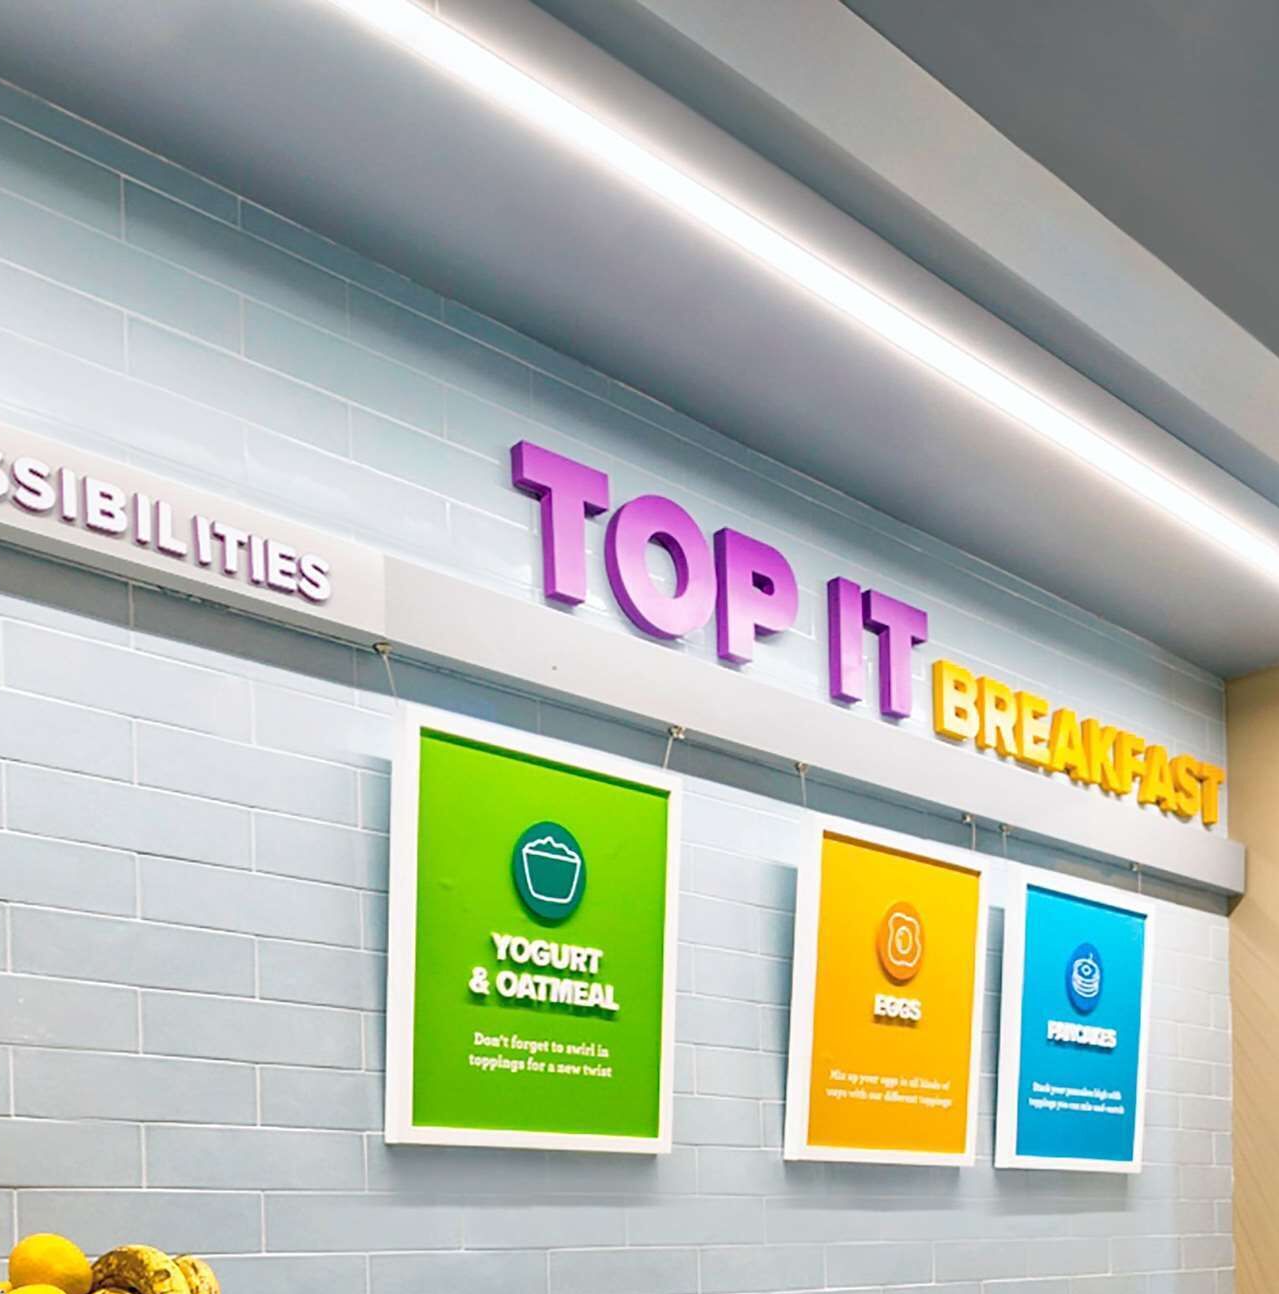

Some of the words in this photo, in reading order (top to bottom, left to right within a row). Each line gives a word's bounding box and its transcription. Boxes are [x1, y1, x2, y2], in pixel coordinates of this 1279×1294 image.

[510, 440, 799, 666] TOP
[827, 577, 928, 720] IT
[931, 659, 1225, 826] BREAKFAST
[490, 931, 603, 974] YOGURT
[469, 966, 490, 995] &
[495, 970, 620, 1011] OATMEAL
[874, 993, 922, 1021] EGGS
[474, 1032, 509, 1048] Don't
[511, 1034, 549, 1054] forget
[551, 1041, 564, 1053] to
[566, 1042, 595, 1058] swirl
[597, 1043, 609, 1058] in
[1047, 1019, 1117, 1048] PANCAKES
[468, 1053, 525, 1073] toppings
[527, 1056, 546, 1072] for
[547, 1062, 556, 1073] a
[557, 1063, 581, 1075] new
[583, 1063, 613, 1077] twist
